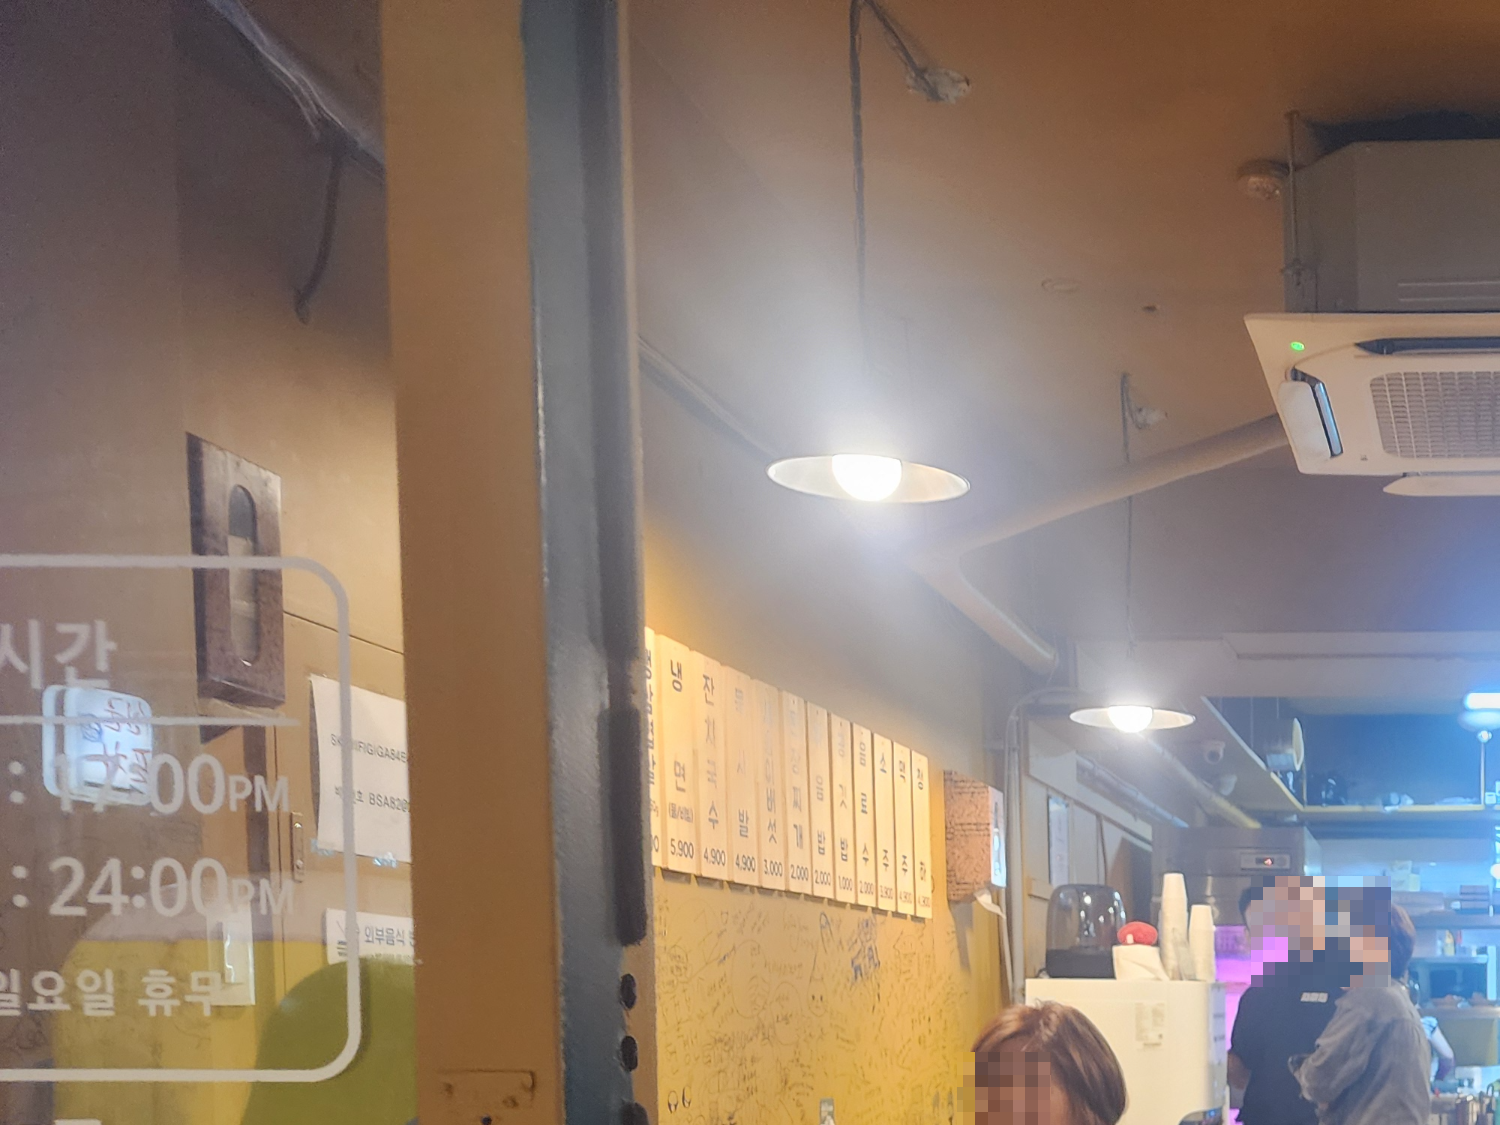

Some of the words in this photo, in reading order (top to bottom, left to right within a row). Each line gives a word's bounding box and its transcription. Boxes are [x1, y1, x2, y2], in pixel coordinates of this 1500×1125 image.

[670, 658, 686, 793] 냉면
[702, 673, 718, 830] 잔치국수
[859, 741, 869, 866] 음료수
[879, 752, 890, 871] 소주
[670, 837, 695, 860] 5,900
[703, 846, 726, 867] 4,900
[735, 853, 757, 873] 4,900
[763, 859, 783, 878] 3,000
[790, 864, 809, 882] 2,000
[49, 856, 298, 918] 24:00PM
[814, 869, 831, 886] 2,000
[838, 875, 853, 892] 1,000
[859, 880, 874, 896] 2,000
[364, 925, 406, 947] 외부음식
[139, 968, 233, 1017] 휴무
